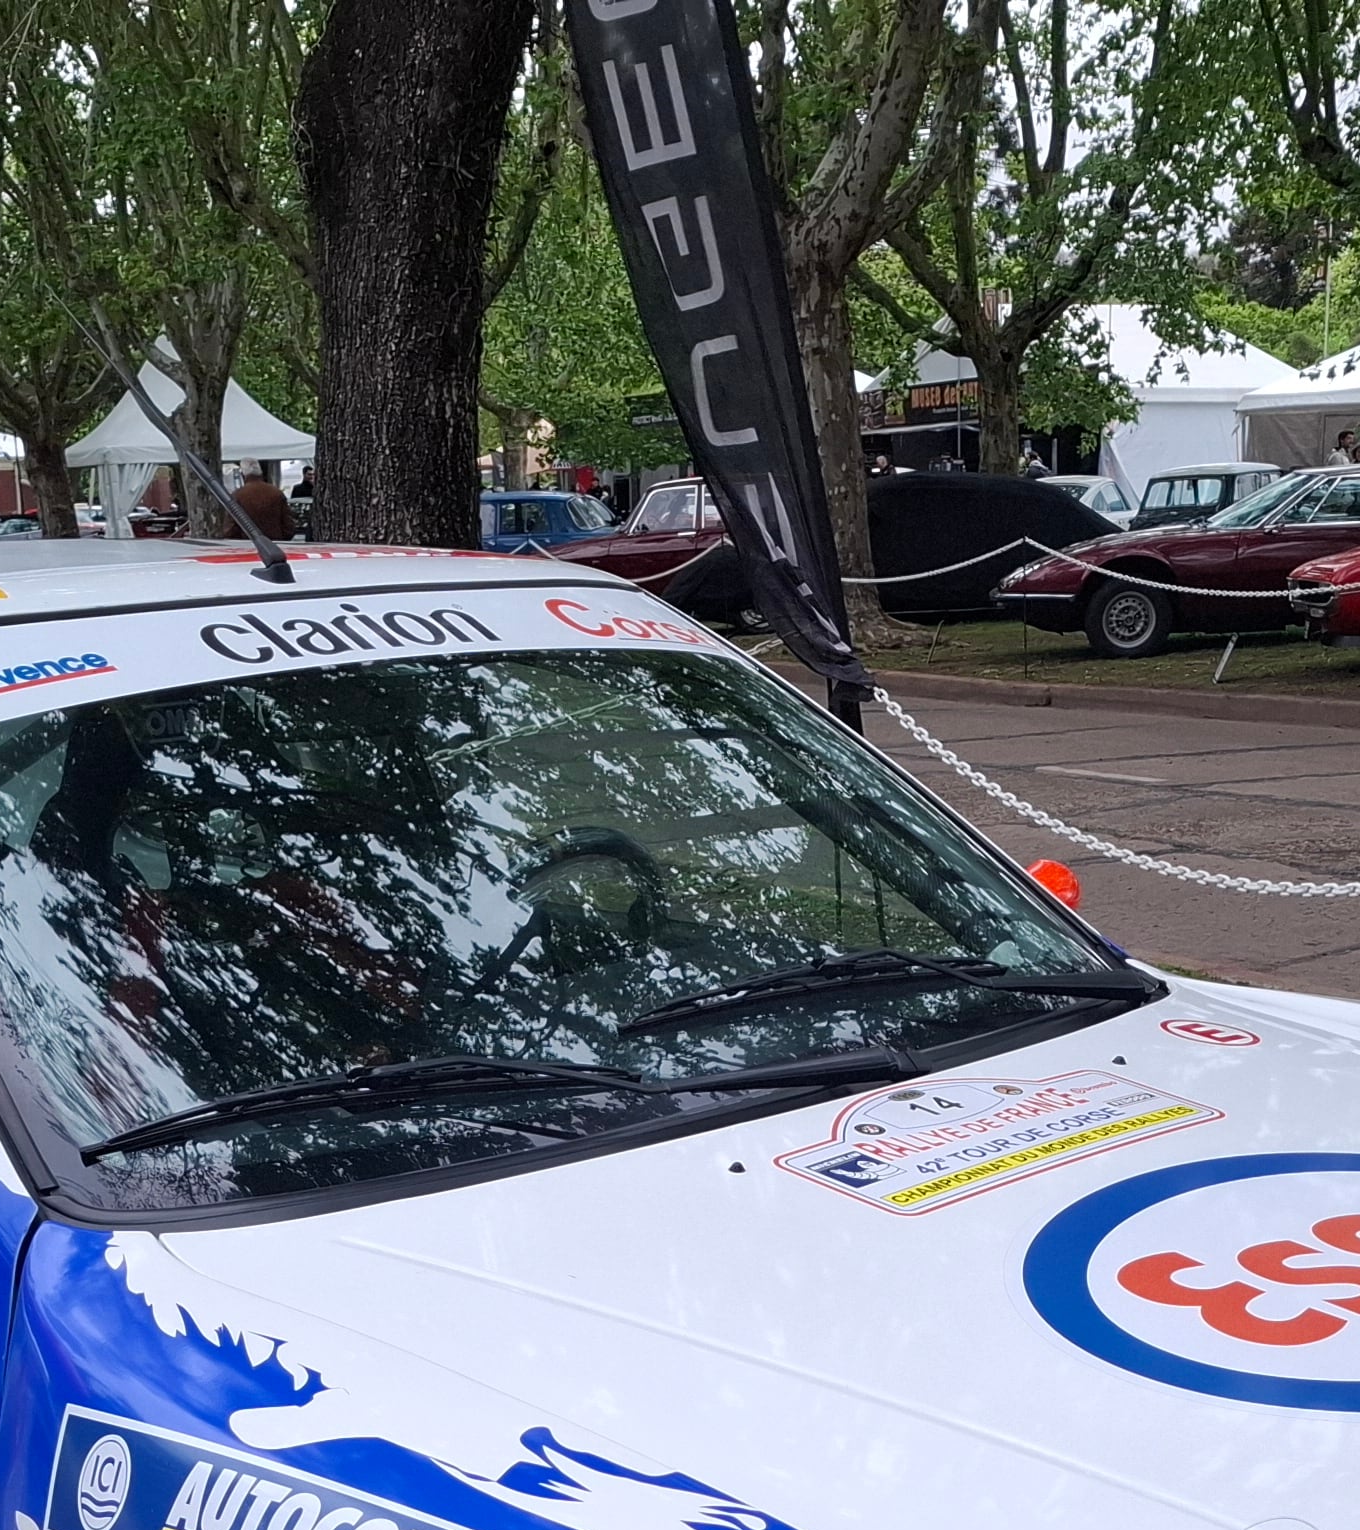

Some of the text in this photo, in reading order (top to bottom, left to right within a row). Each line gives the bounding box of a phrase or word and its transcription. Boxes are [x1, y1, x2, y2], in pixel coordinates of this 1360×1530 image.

[199, 602, 502, 665] Clarion
[1182, 1022, 1244, 1047] E
[852, 1087, 1090, 1161] RALLYE DE FRANCE
[909, 1096, 965, 1116] 14
[947, 1137, 1019, 1163] TOUR
[1012, 1127, 1052, 1143] DE
[1046, 1106, 1126, 1132] CORSE
[891, 1105, 1195, 1204] CHAMPIONNAT DU MONDE DES RALLYES
[89, 1452, 123, 1496] ICI
